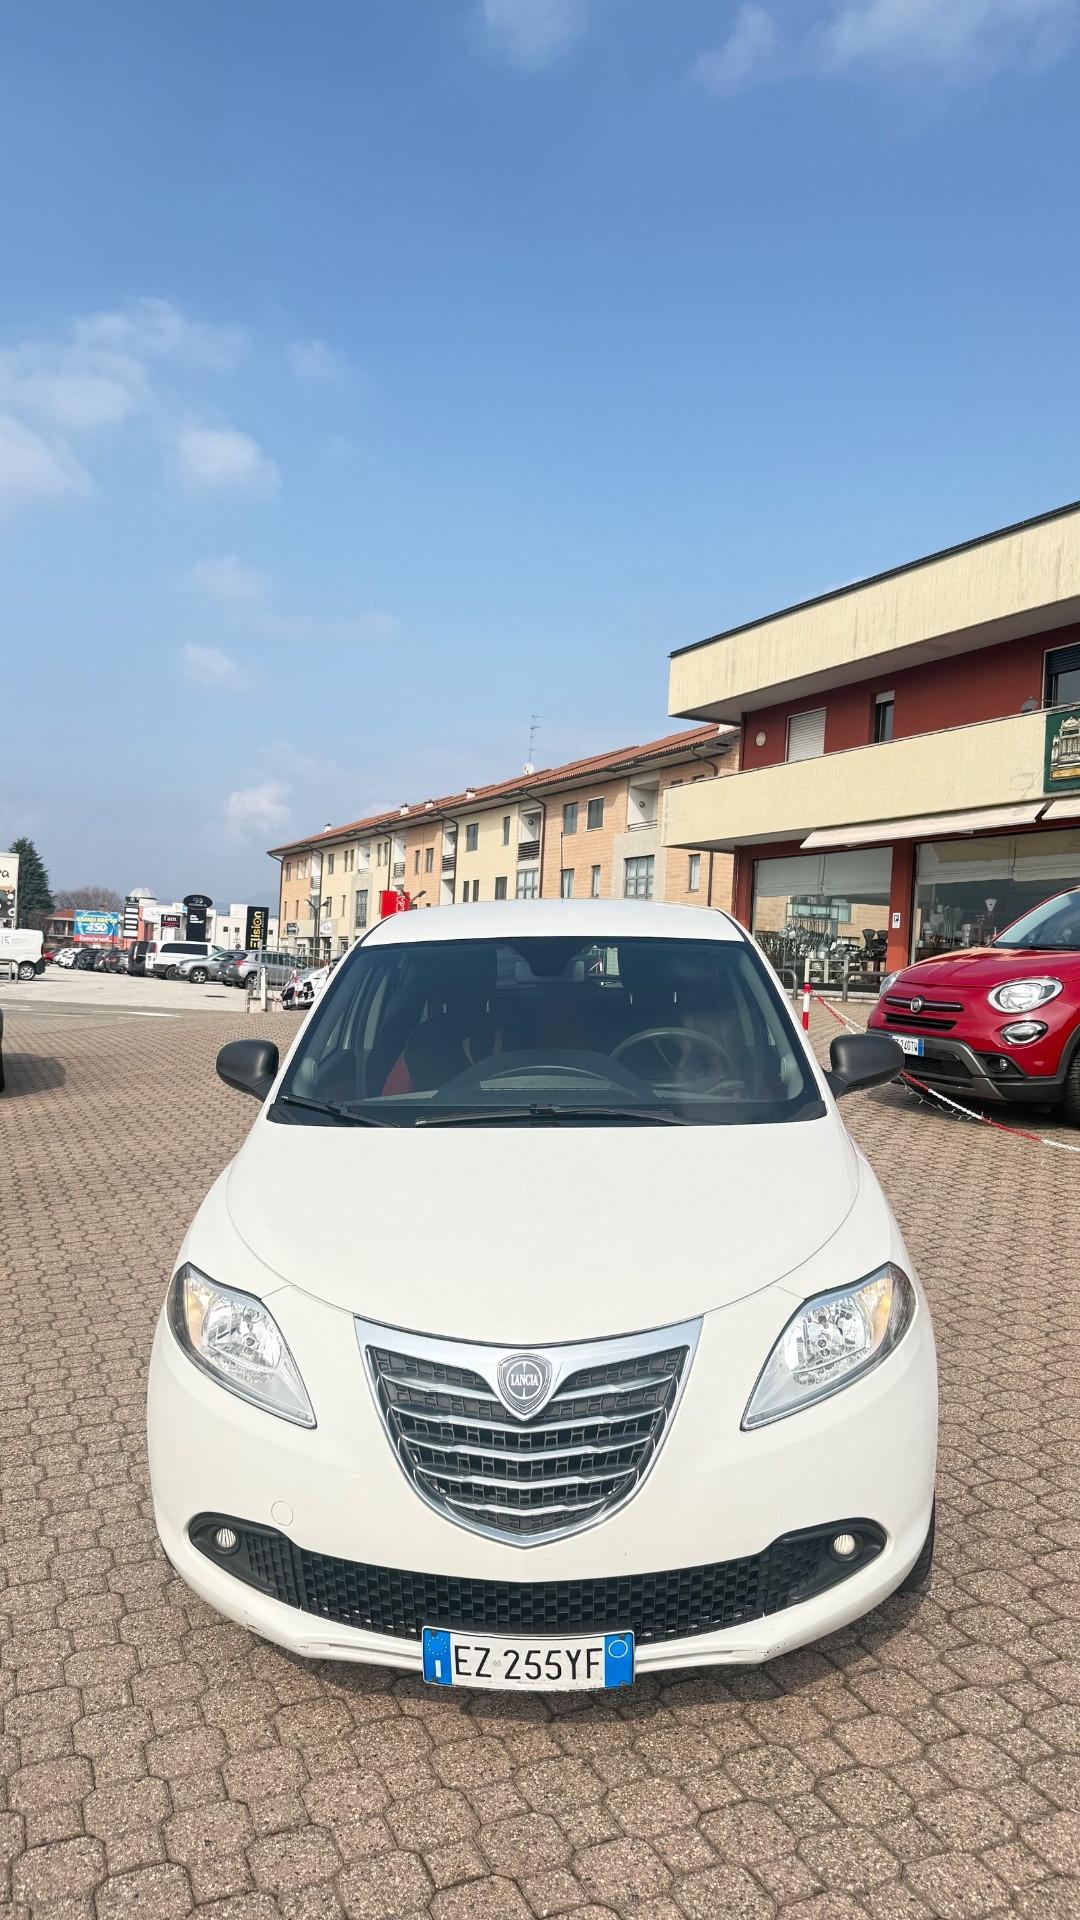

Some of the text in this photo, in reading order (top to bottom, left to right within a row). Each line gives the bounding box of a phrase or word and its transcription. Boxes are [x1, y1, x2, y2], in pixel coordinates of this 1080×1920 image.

[510, 1373, 539, 1386] LANCIA
[454, 1645, 603, 1680] EZ 255YF
